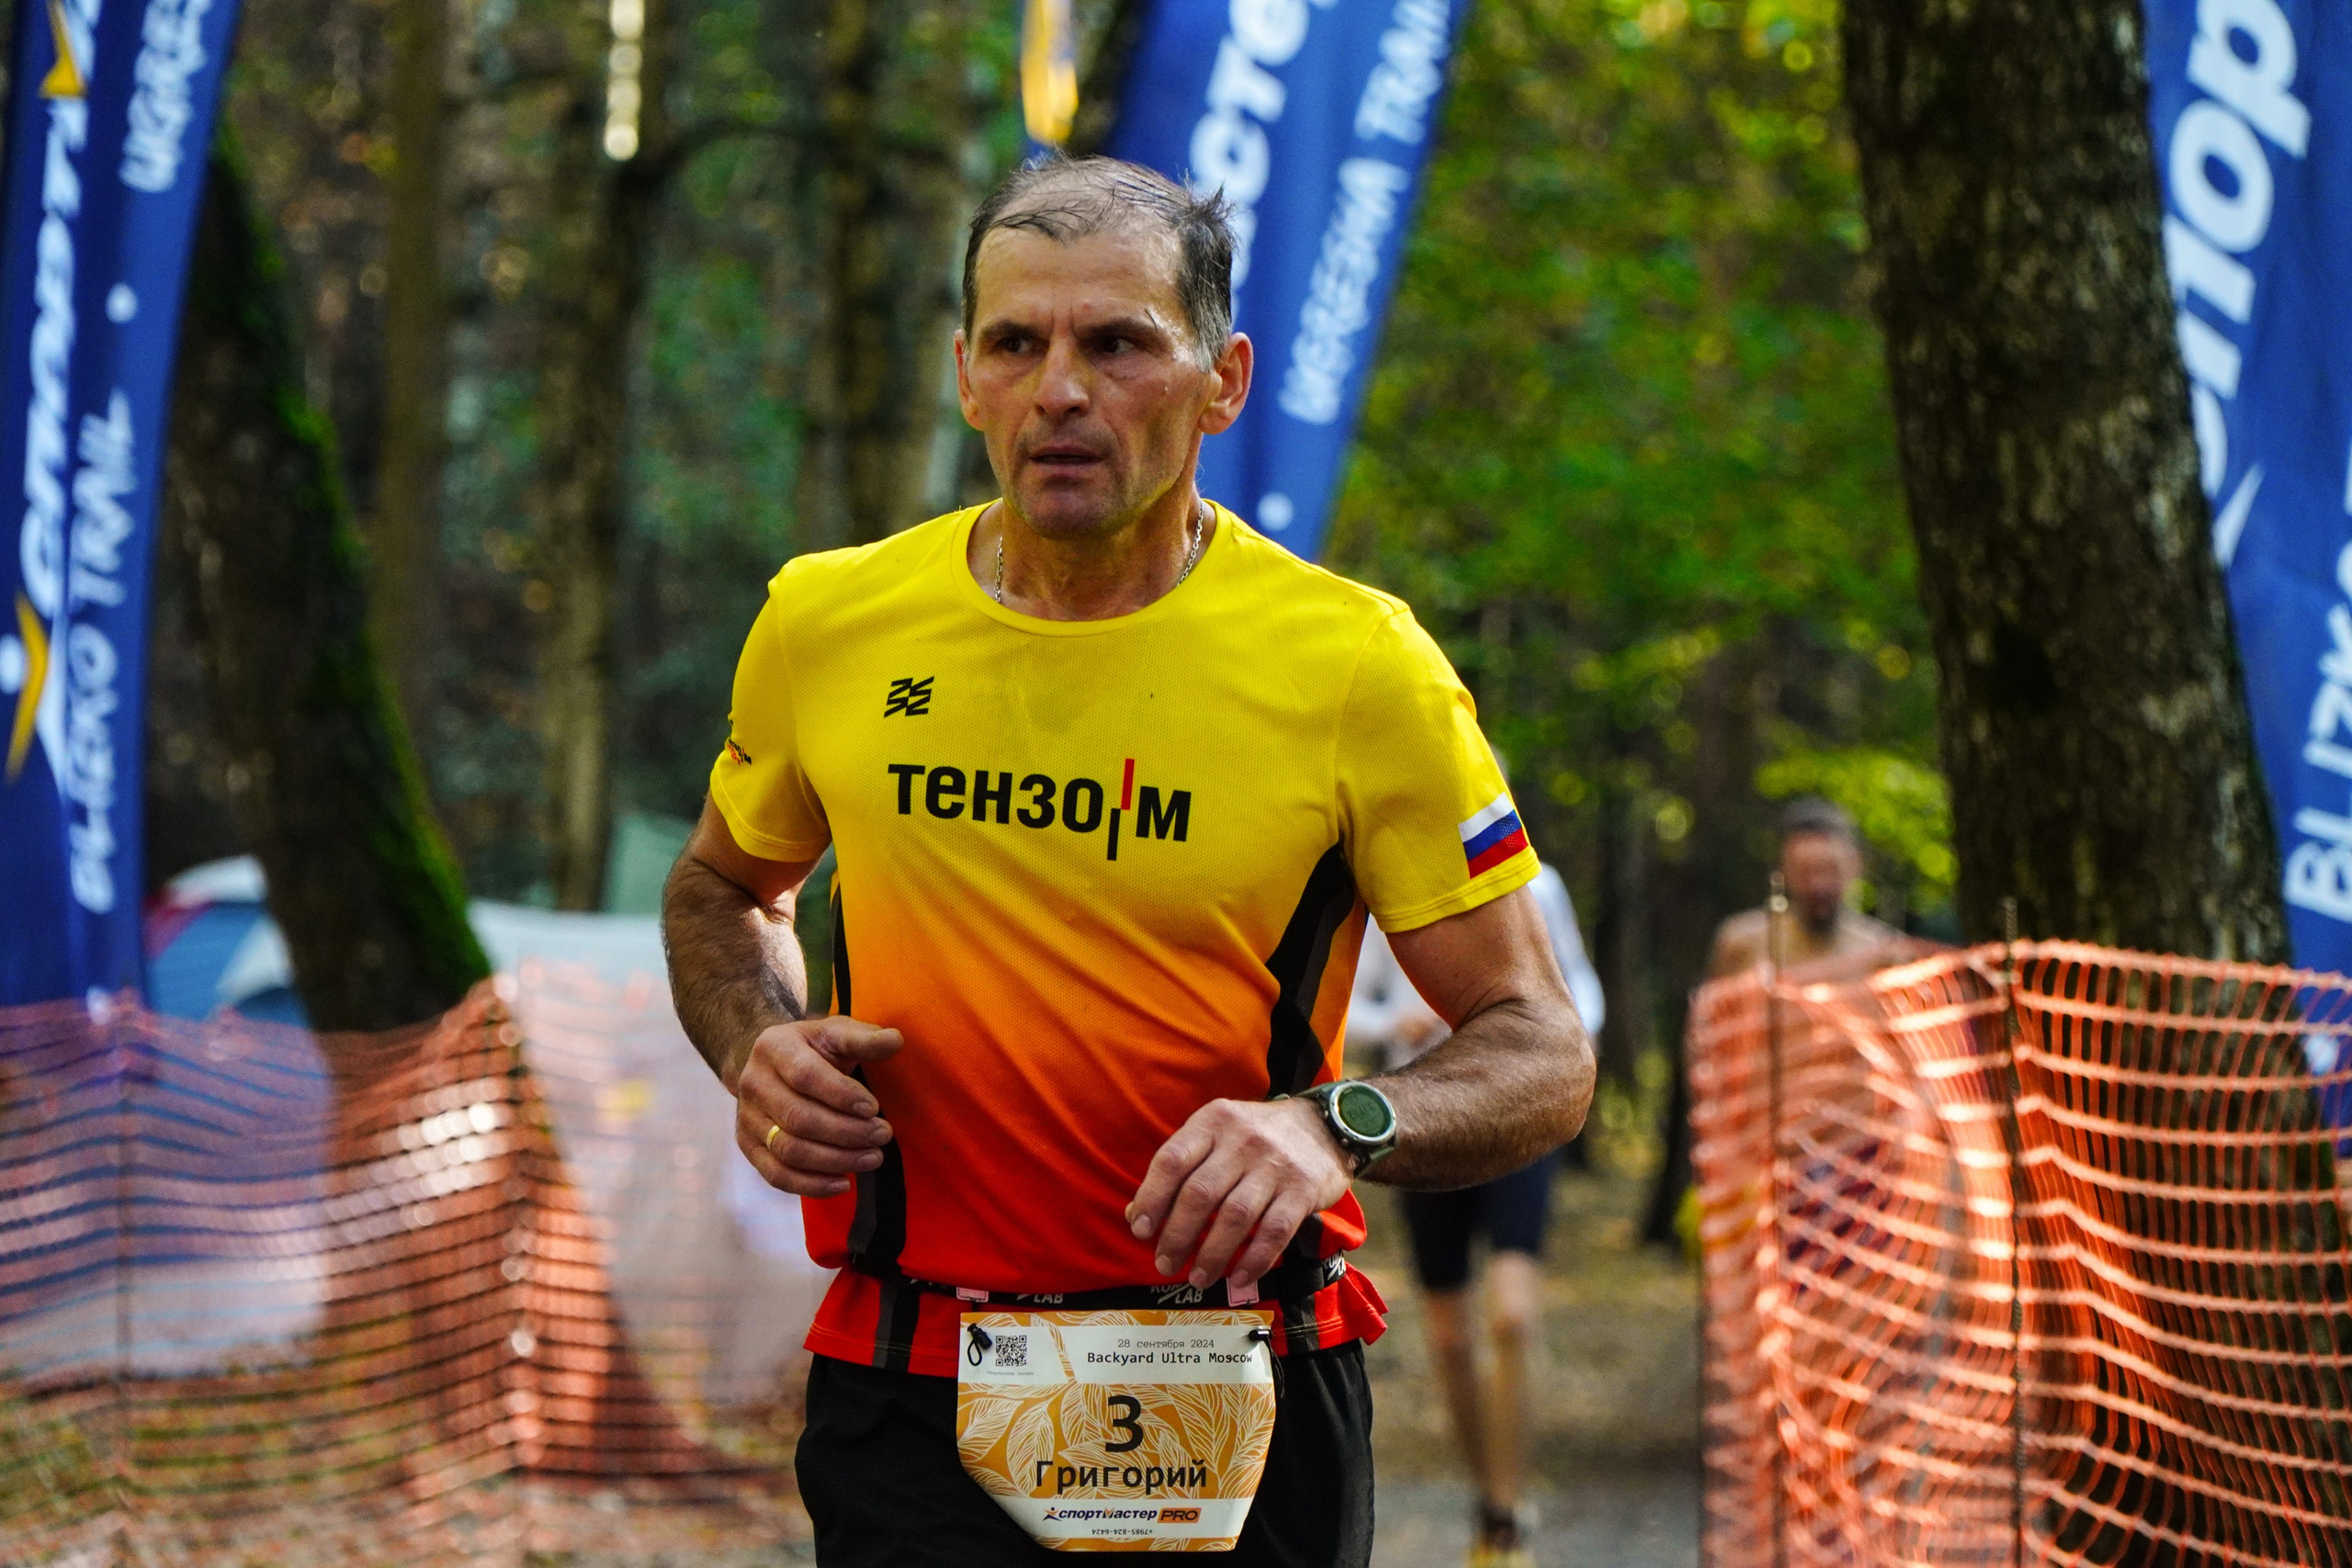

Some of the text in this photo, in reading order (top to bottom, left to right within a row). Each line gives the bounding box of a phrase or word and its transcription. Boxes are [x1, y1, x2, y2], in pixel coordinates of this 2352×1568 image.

[1174, 1288, 1204, 1304] LAB
[1117, 1338, 1215, 1349] 28 сентября 2024
[1087, 1351, 1252, 1366] Backyard Ultra Moscow
[1104, 1394, 1145, 1453] 3
[1035, 1459, 1207, 1495] Григорий
[1160, 1509, 1199, 1521] PRO
